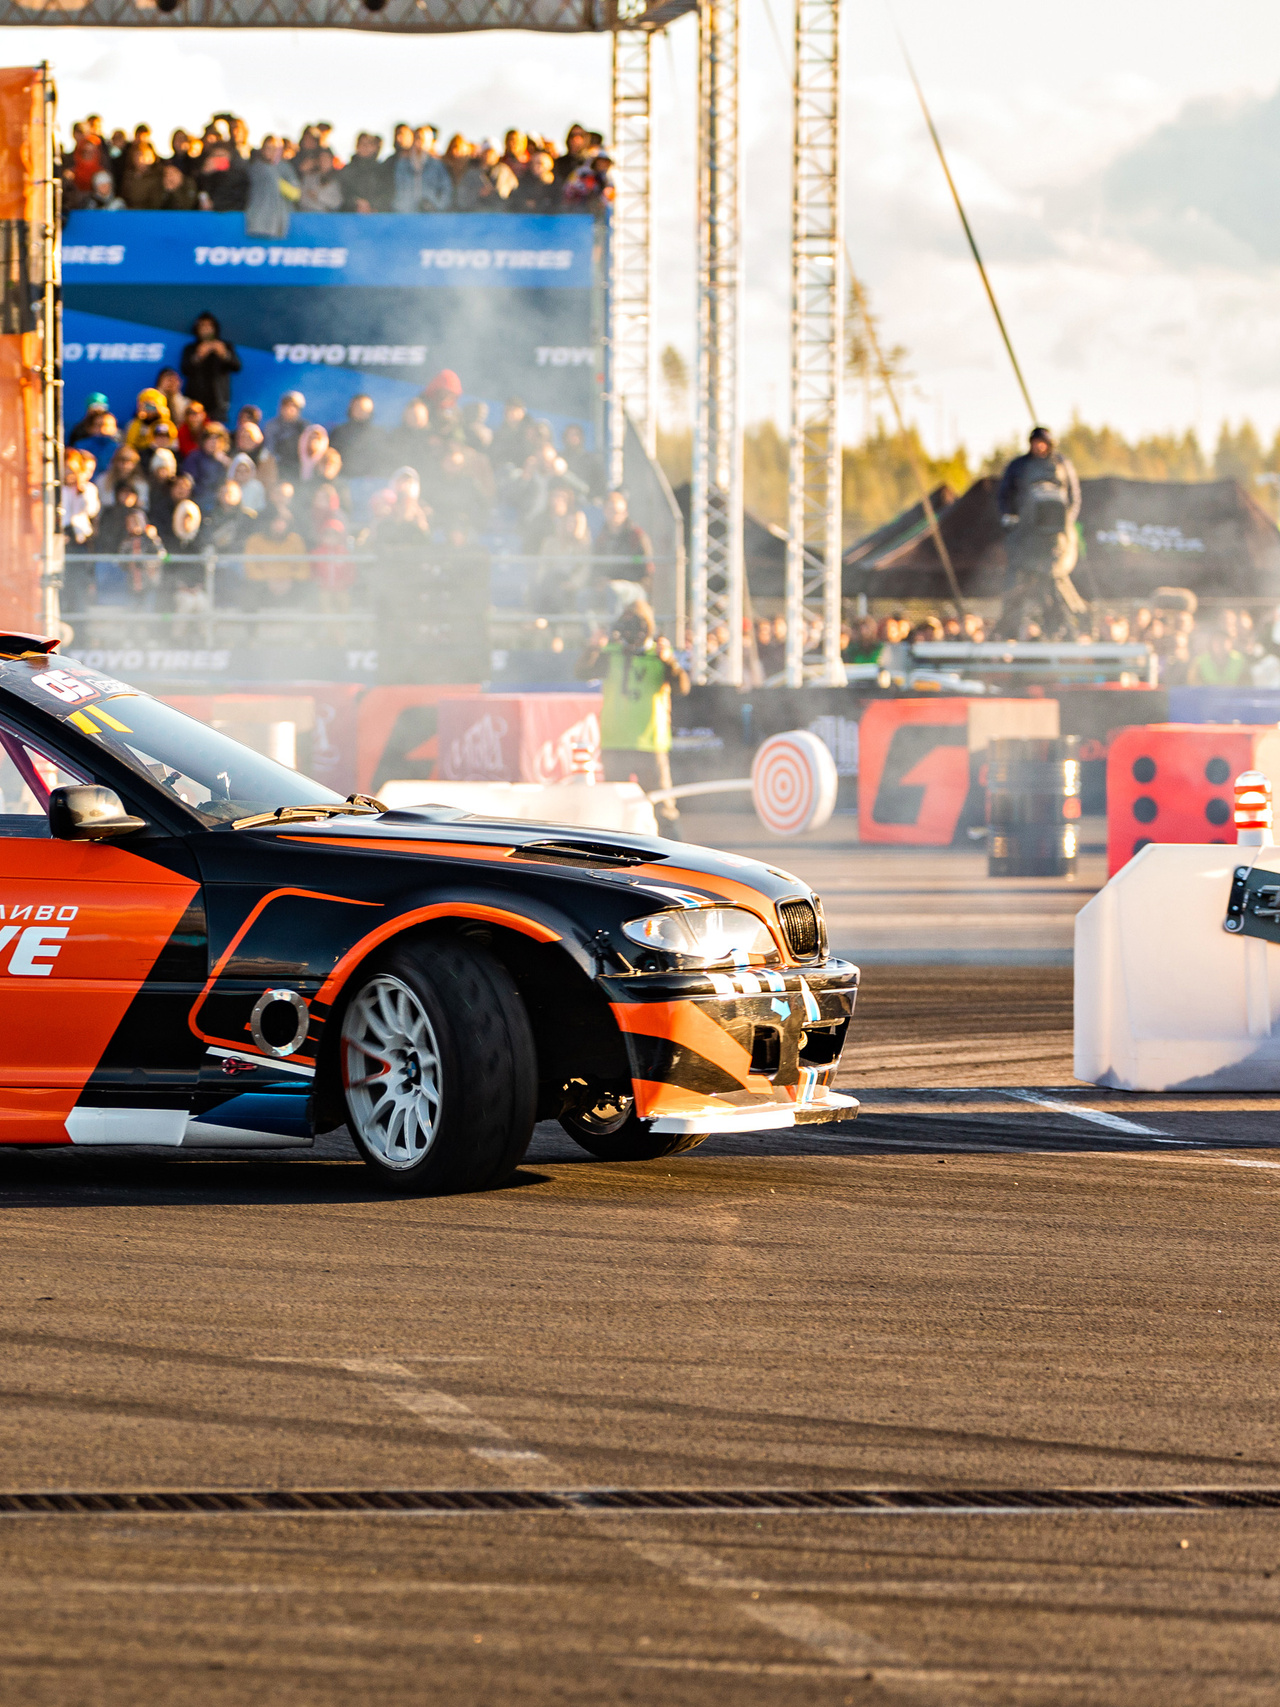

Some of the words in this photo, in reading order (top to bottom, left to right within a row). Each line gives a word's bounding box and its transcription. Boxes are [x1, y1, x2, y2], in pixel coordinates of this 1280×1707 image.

[61, 245, 126, 265] IRES
[194, 247, 265, 266] TOYO
[267, 247, 348, 268] TIRES
[421, 249, 489, 269] TOYO
[492, 249, 573, 270] TIRES
[85, 342, 165, 362] TIRES
[273, 344, 344, 364] TOYO
[347, 344, 428, 366] TIRES
[535, 346, 596, 366] TOY
